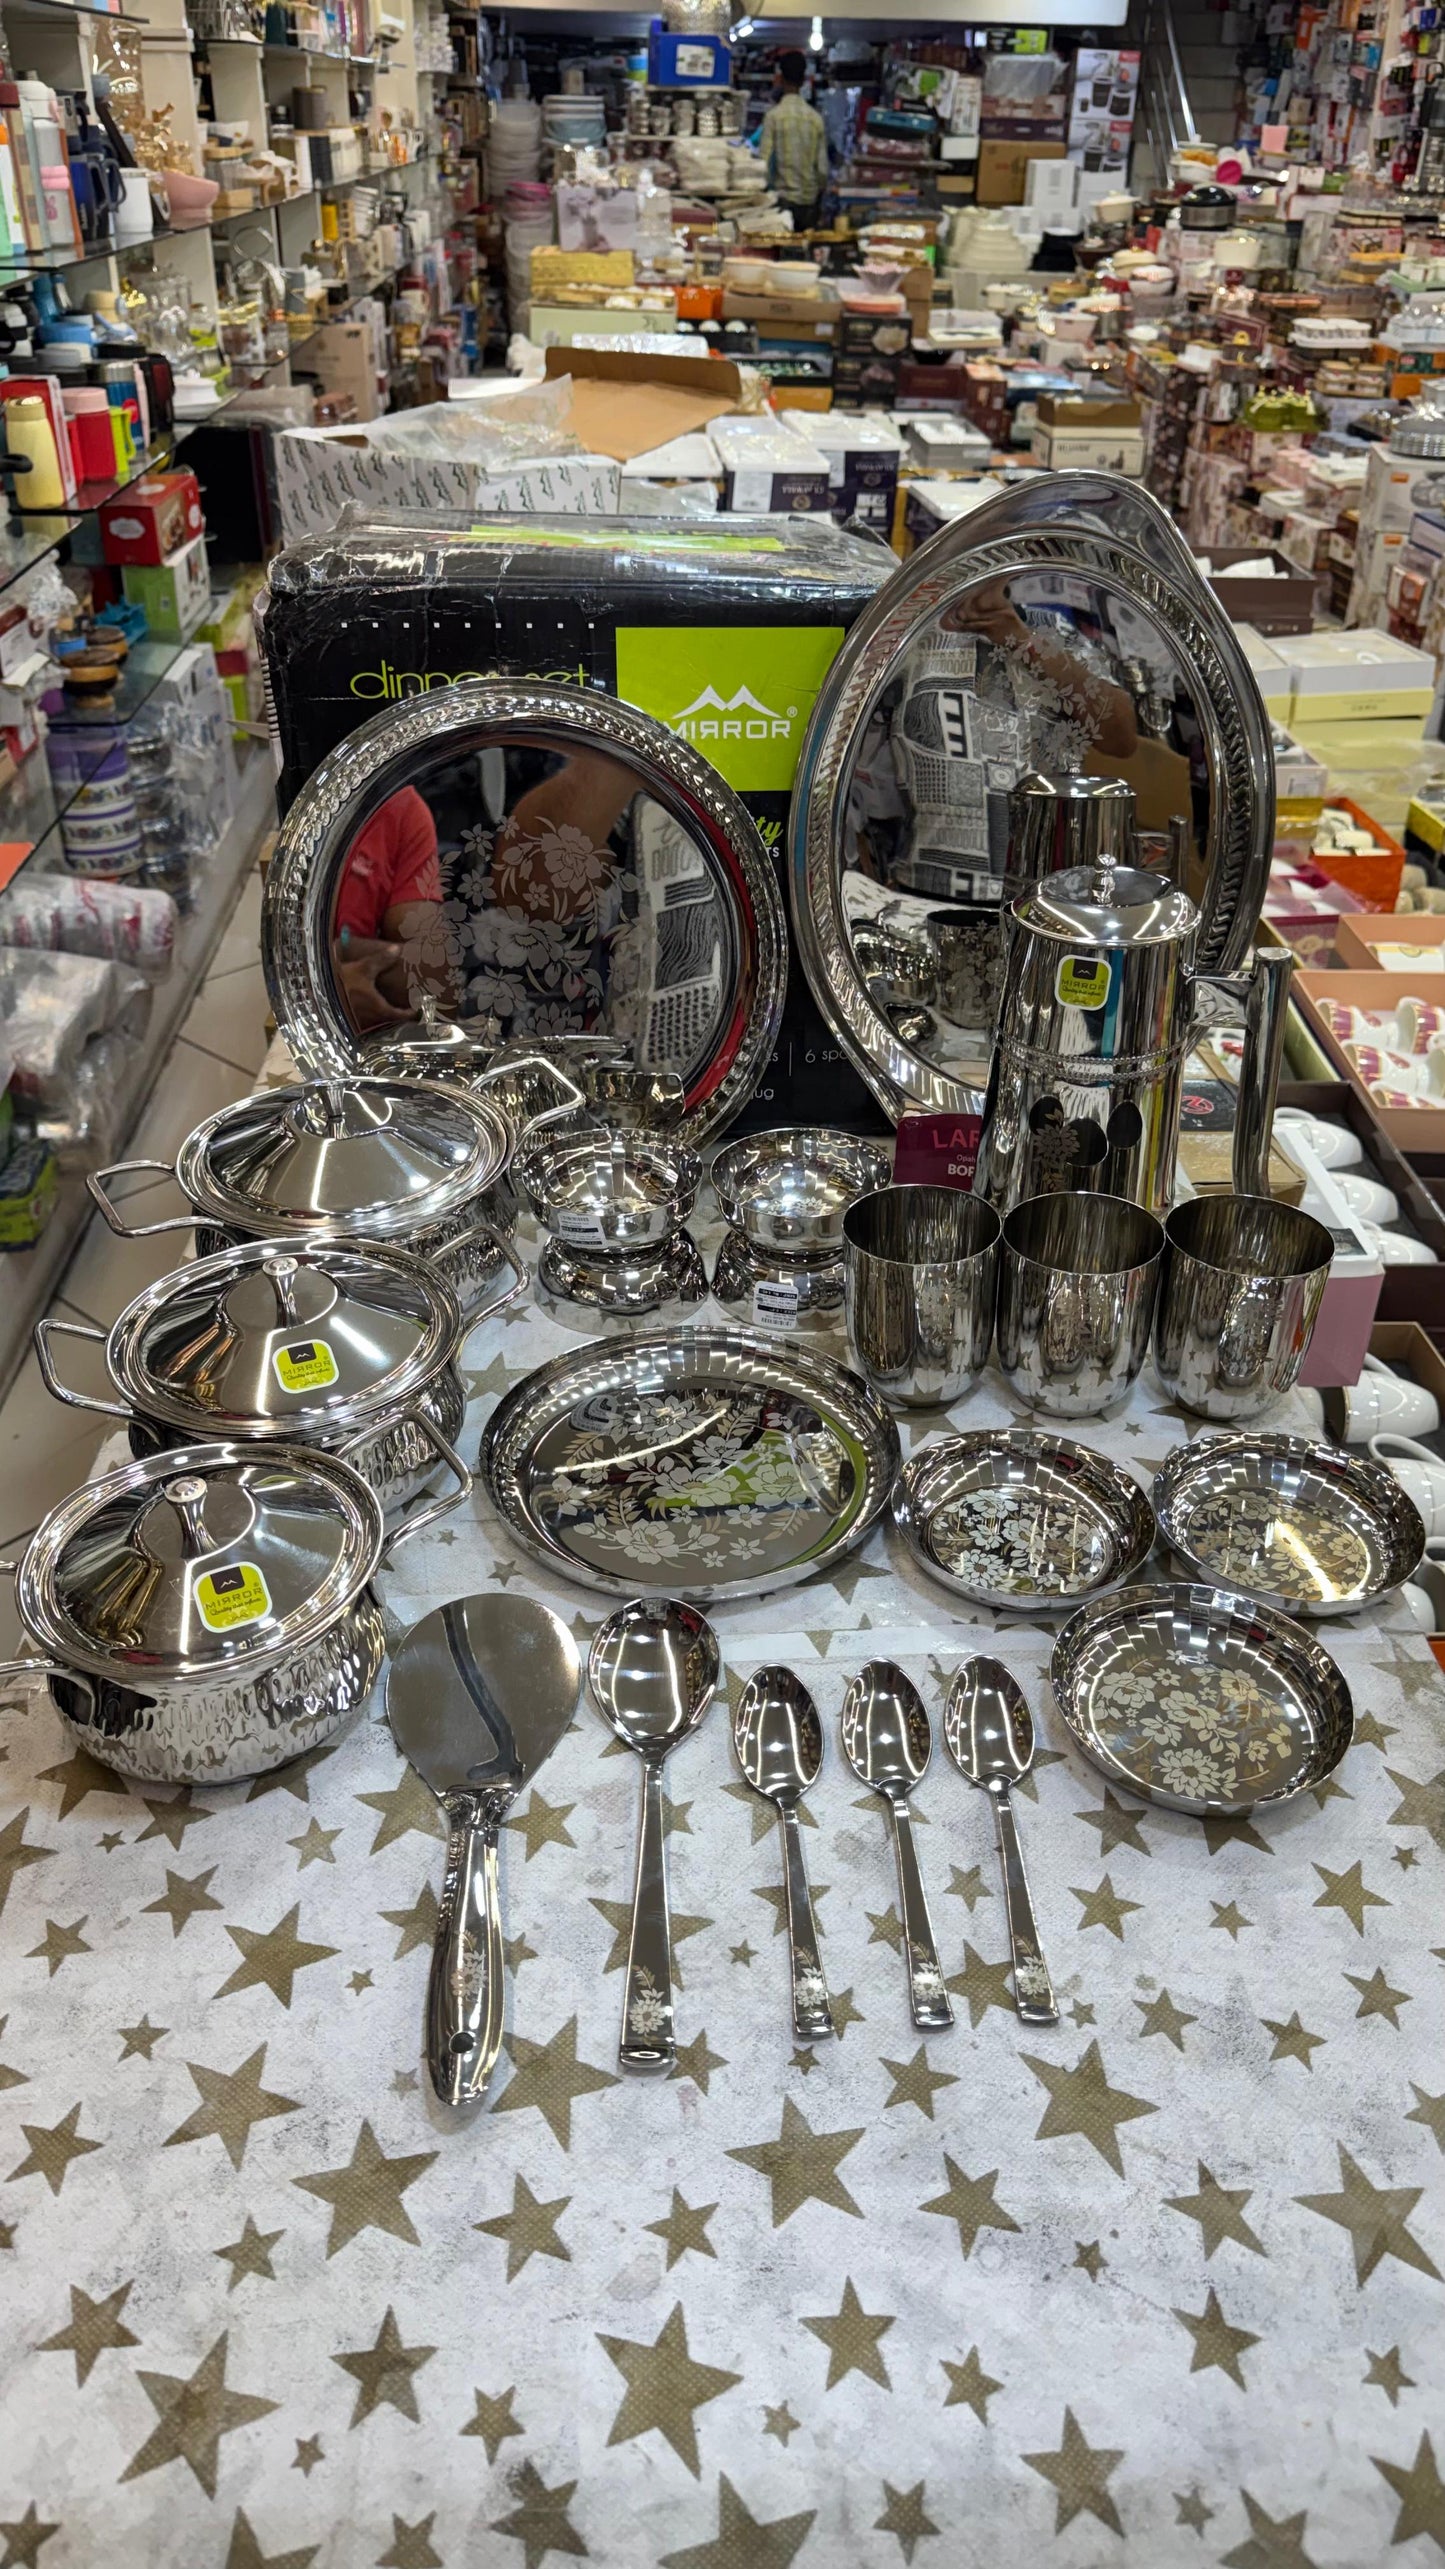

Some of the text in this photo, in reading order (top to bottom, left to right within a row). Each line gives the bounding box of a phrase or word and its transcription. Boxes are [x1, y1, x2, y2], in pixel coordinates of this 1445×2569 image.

[663, 719, 791, 740] MIRROR
[1061, 978, 1106, 991] MIRROR
[805, 1049, 816, 1063] 6
[751, 1088, 774, 1101] ug
[282, 1360, 331, 1376] MIRROR
[205, 1586, 263, 1611] MIRROR
